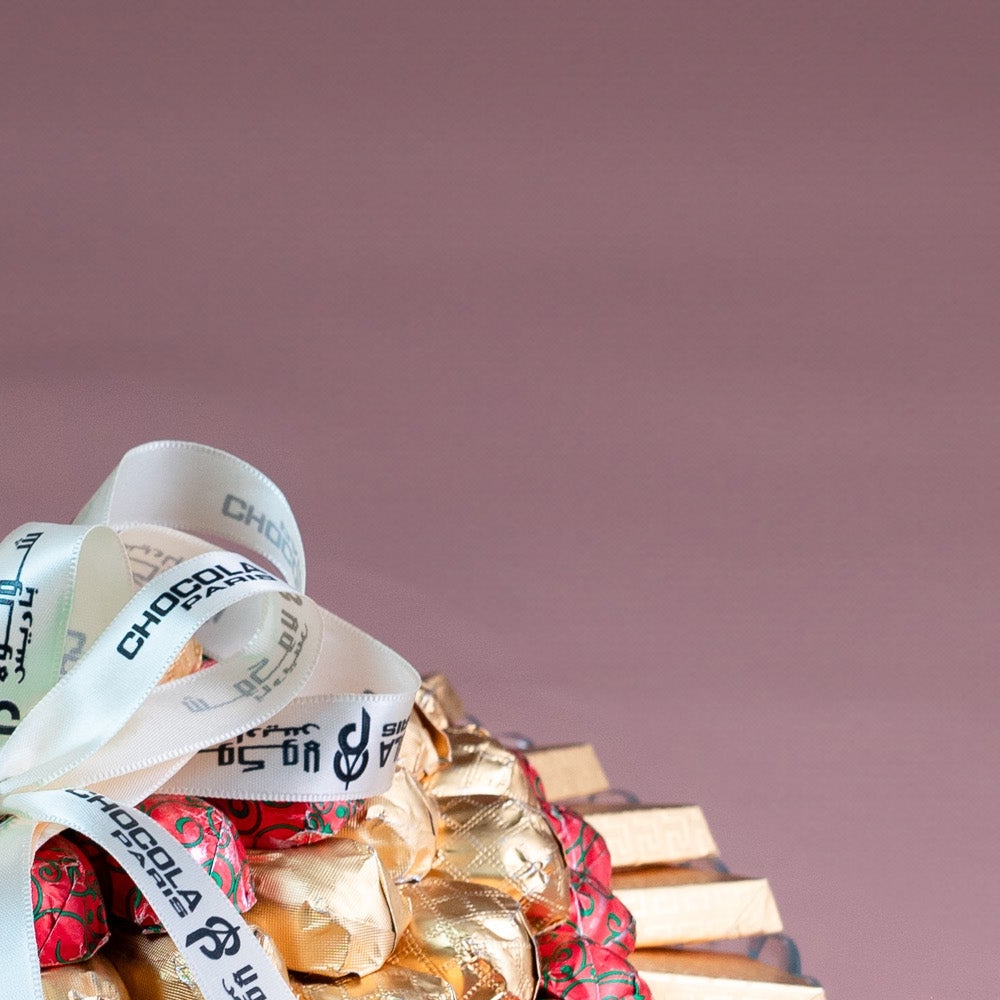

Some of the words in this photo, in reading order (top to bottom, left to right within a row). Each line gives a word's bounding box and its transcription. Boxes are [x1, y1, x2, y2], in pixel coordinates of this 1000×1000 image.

[116, 561, 265, 661] CHOCOLA
[180, 571, 279, 612] PARIS
[65, 789, 203, 912] CHOCOLA
[110, 829, 190, 918] PARIS
